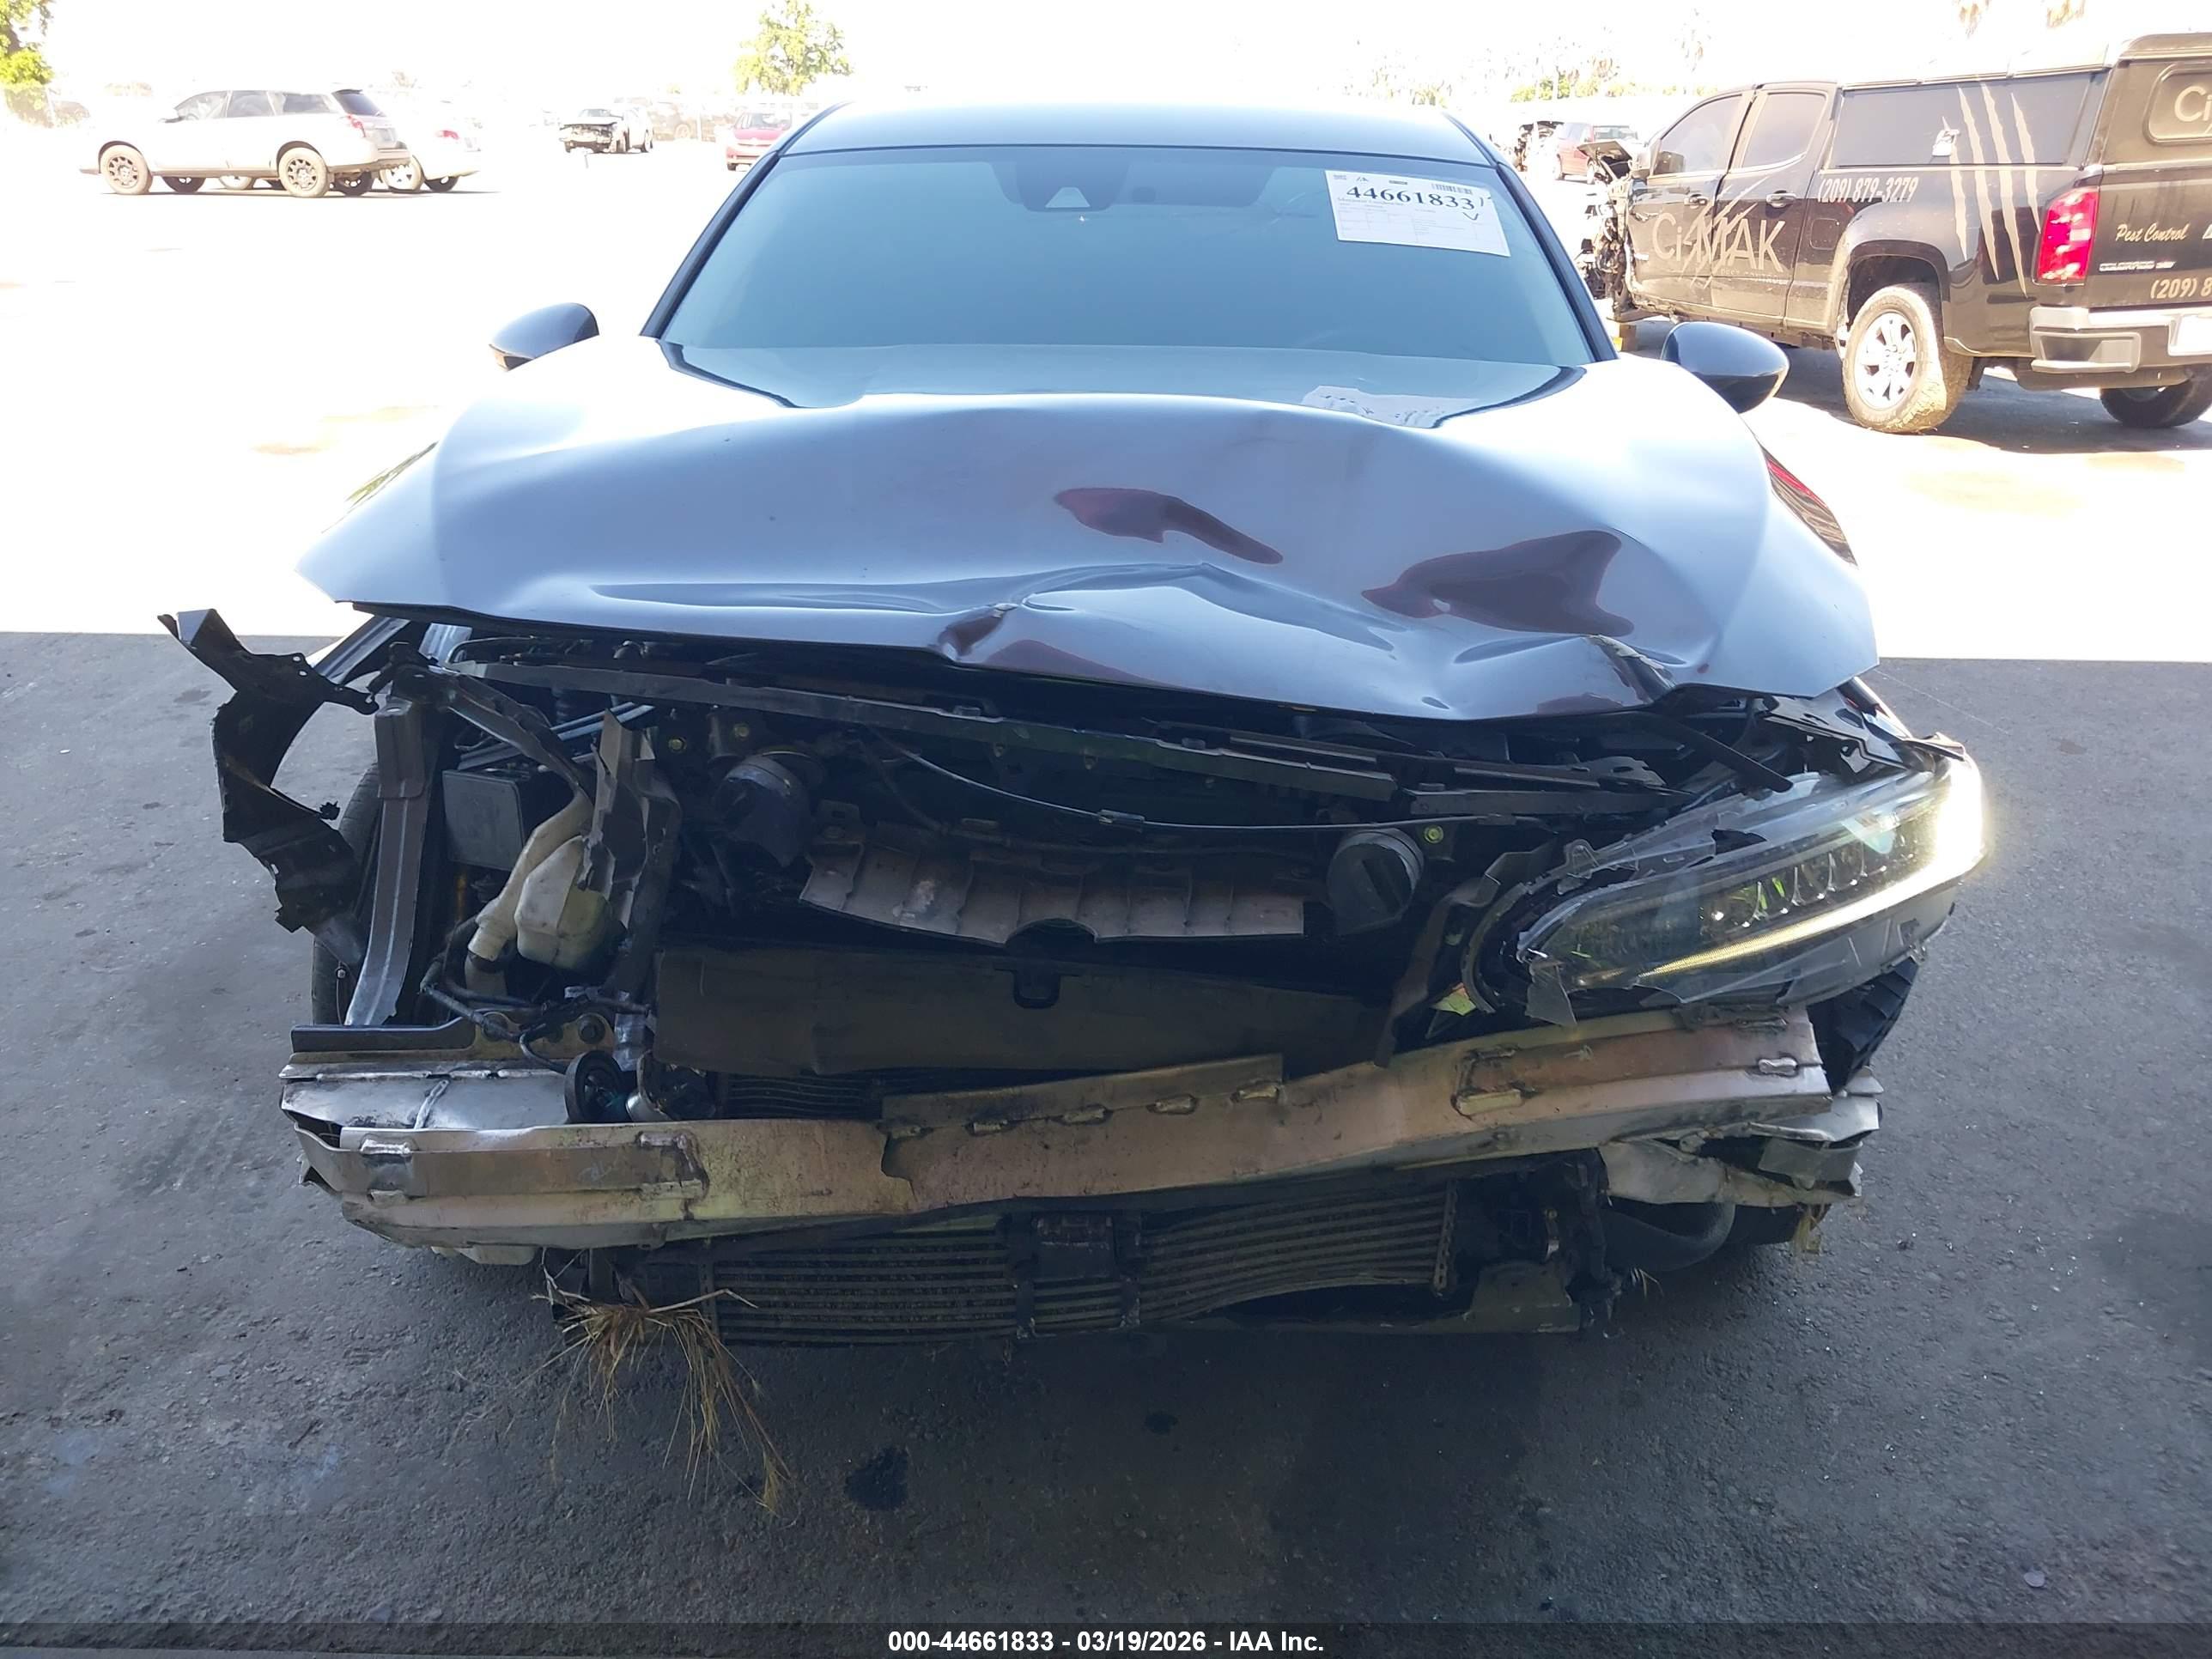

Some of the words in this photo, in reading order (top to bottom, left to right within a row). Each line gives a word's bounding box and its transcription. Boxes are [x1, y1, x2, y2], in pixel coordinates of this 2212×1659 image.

[1346, 185, 1475, 210] 44661833
[1817, 177, 1852, 203] (209)
[1851, 177, 1919, 203] 879-3279
[2115, 223, 2144, 242] Pest
[2144, 221, 2191, 243] Control
[2149, 278, 2198, 300] (209)
